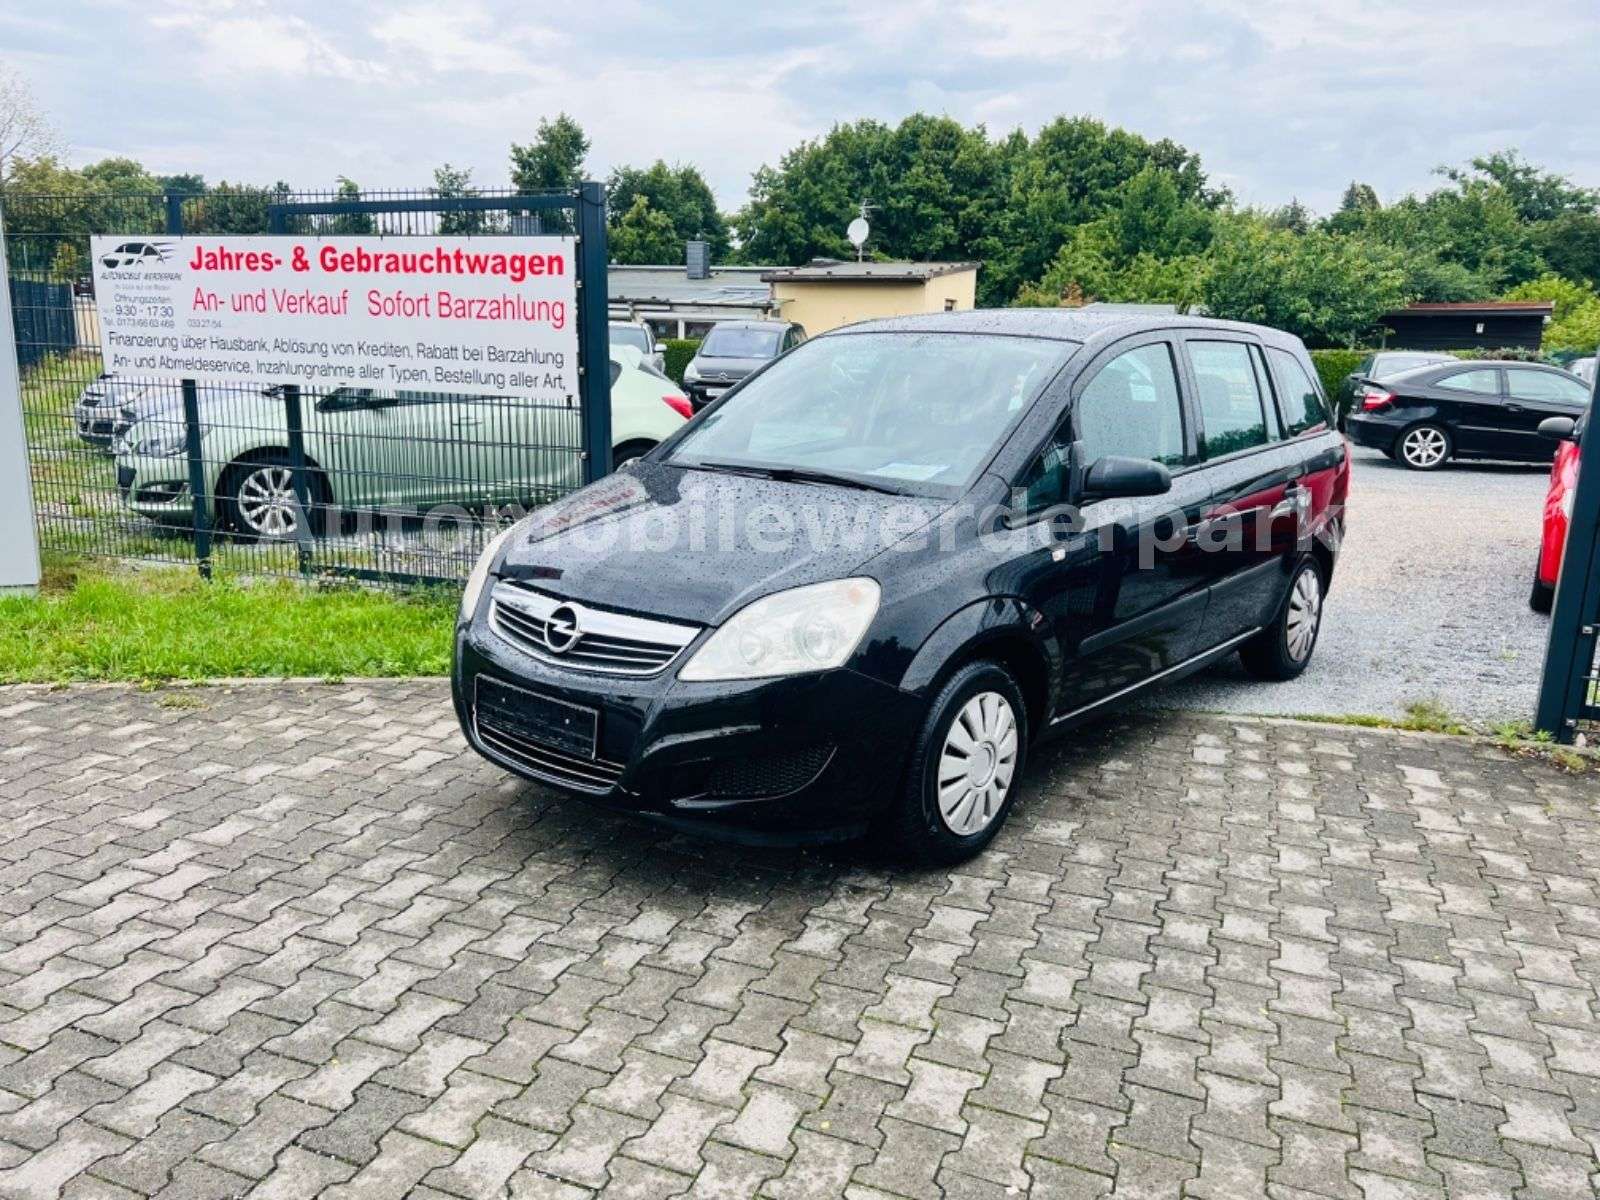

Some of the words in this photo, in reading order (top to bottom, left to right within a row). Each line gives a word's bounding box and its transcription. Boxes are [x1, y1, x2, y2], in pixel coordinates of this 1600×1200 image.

[190, 246, 282, 271] Jahres-
[291, 245, 310, 272] &
[320, 246, 564, 282] Gebrauchtwagen
[193, 287, 225, 312] An-
[232, 288, 266, 314] und
[272, 288, 348, 315] Verkauf
[367, 290, 430, 317] Sofort
[438, 291, 565, 329] Barzahlung
[109, 331, 178, 351] Finanzierung
[182, 334, 207, 349] über
[210, 335, 270, 353] Hausbank,
[273, 338, 329, 357] Ablösung
[331, 344, 353, 355] von
[357, 341, 413, 360] Krediten,
[417, 343, 459, 360] Rabatt
[463, 345, 483, 361] bei
[488, 346, 564, 368] Barzahlung
[112, 353, 131, 368] An-
[134, 354, 155, 369] und
[159, 355, 253, 374] Abmeldeservice,
[256, 359, 355, 379] Inzahlungnahme
[359, 364, 384, 380] aller
[388, 364, 431, 384] Typen,
[434, 367, 505, 389] Bestellung
[509, 371, 539, 388] aller
[543, 373, 566, 391] Art,
